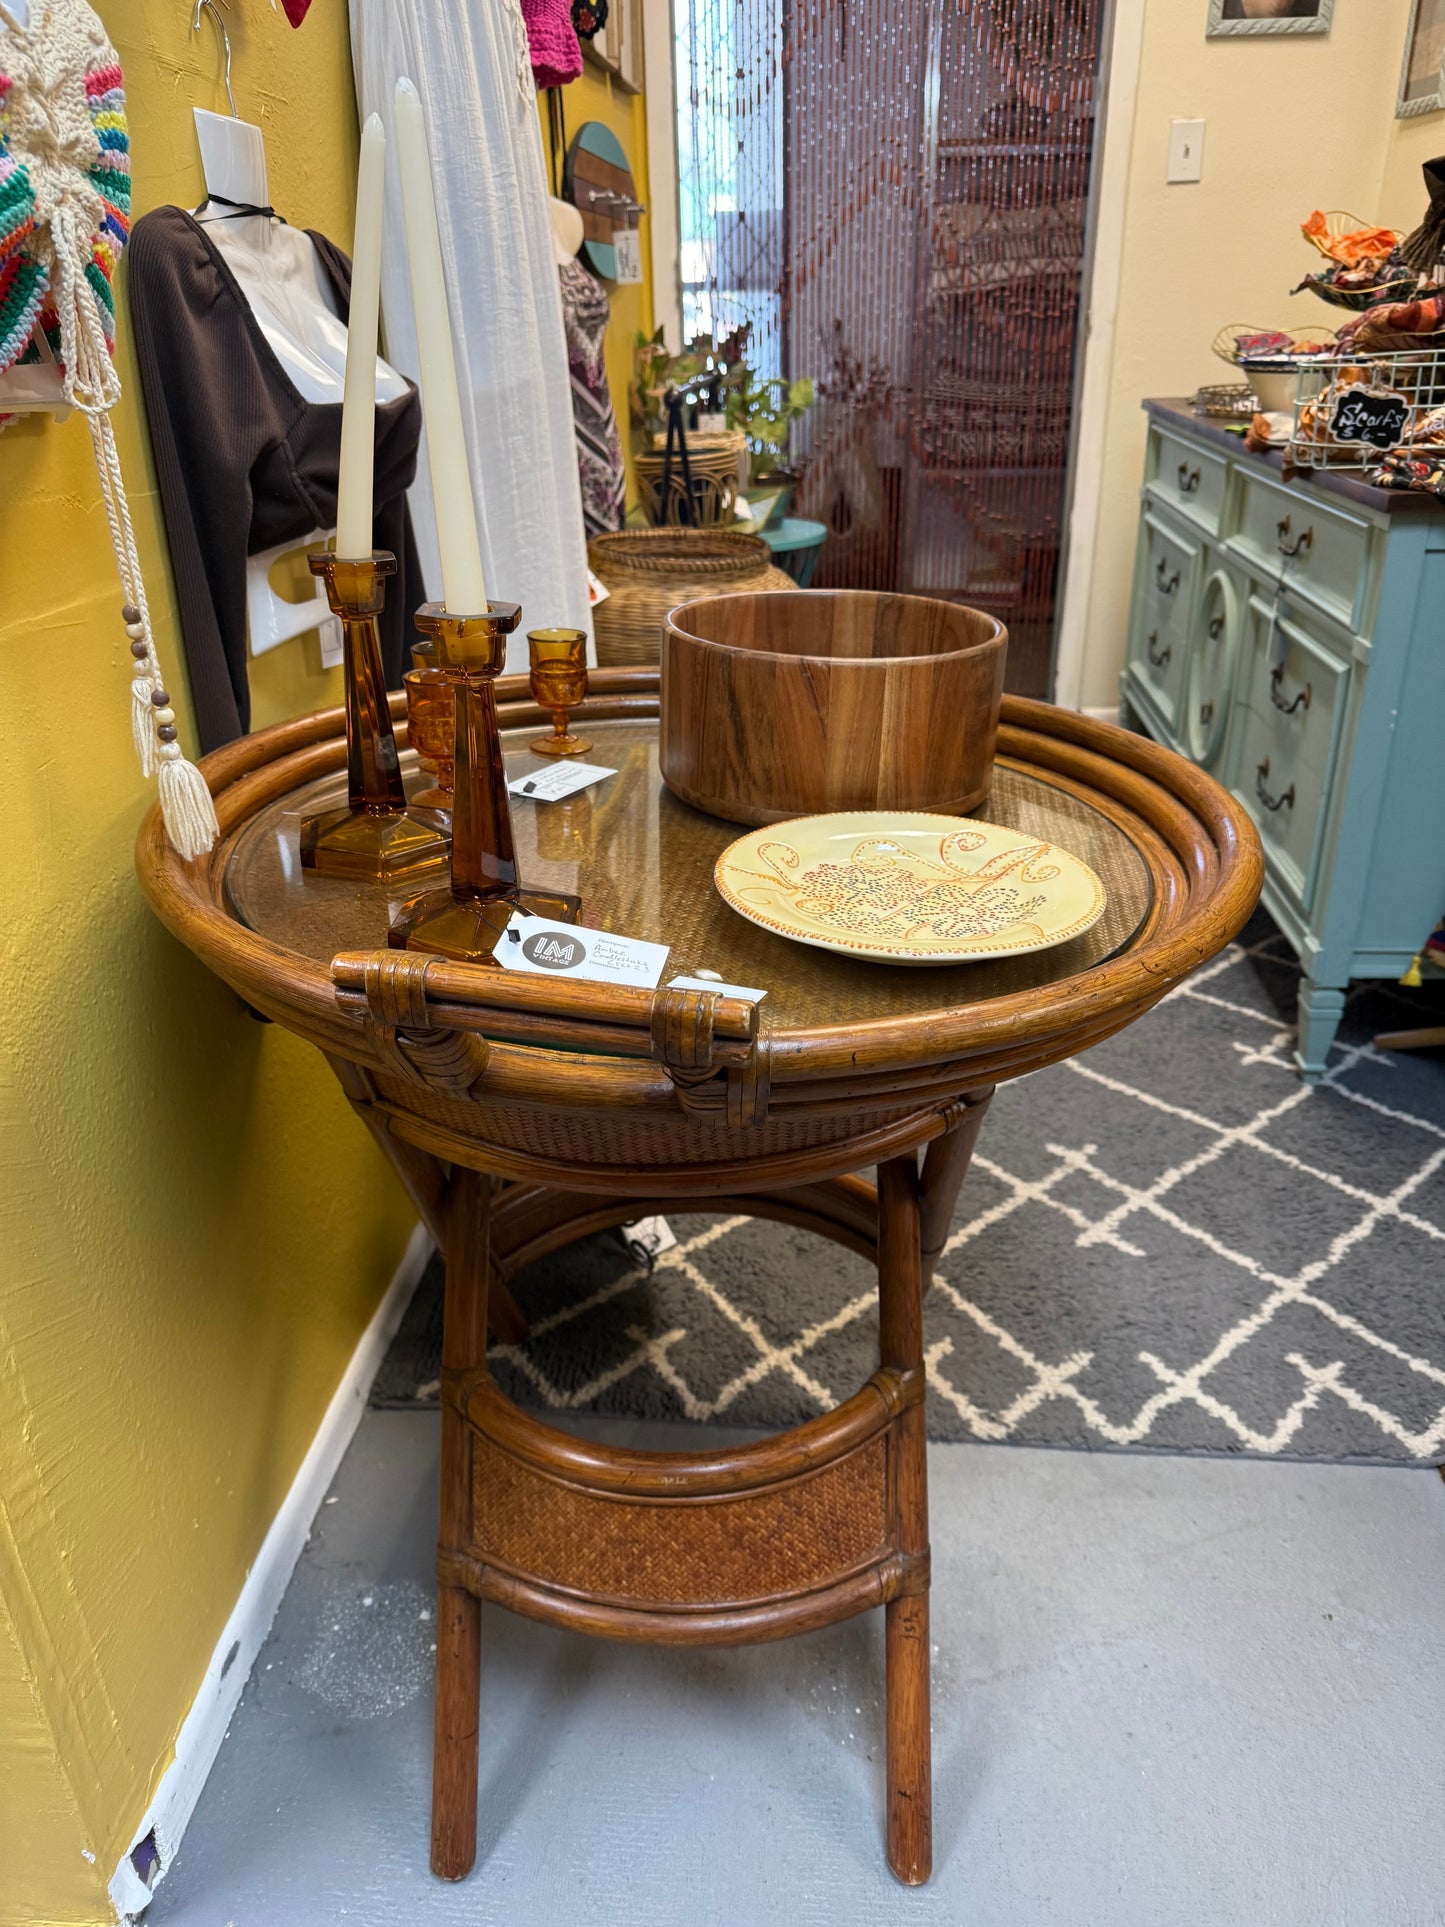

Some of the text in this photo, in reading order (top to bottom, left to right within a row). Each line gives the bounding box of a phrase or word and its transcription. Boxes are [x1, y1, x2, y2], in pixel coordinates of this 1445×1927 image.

[1339, 402, 1404, 428] Scarfs
[532, 952, 571, 966] VINTAGE
[534, 937, 575, 961] IM
